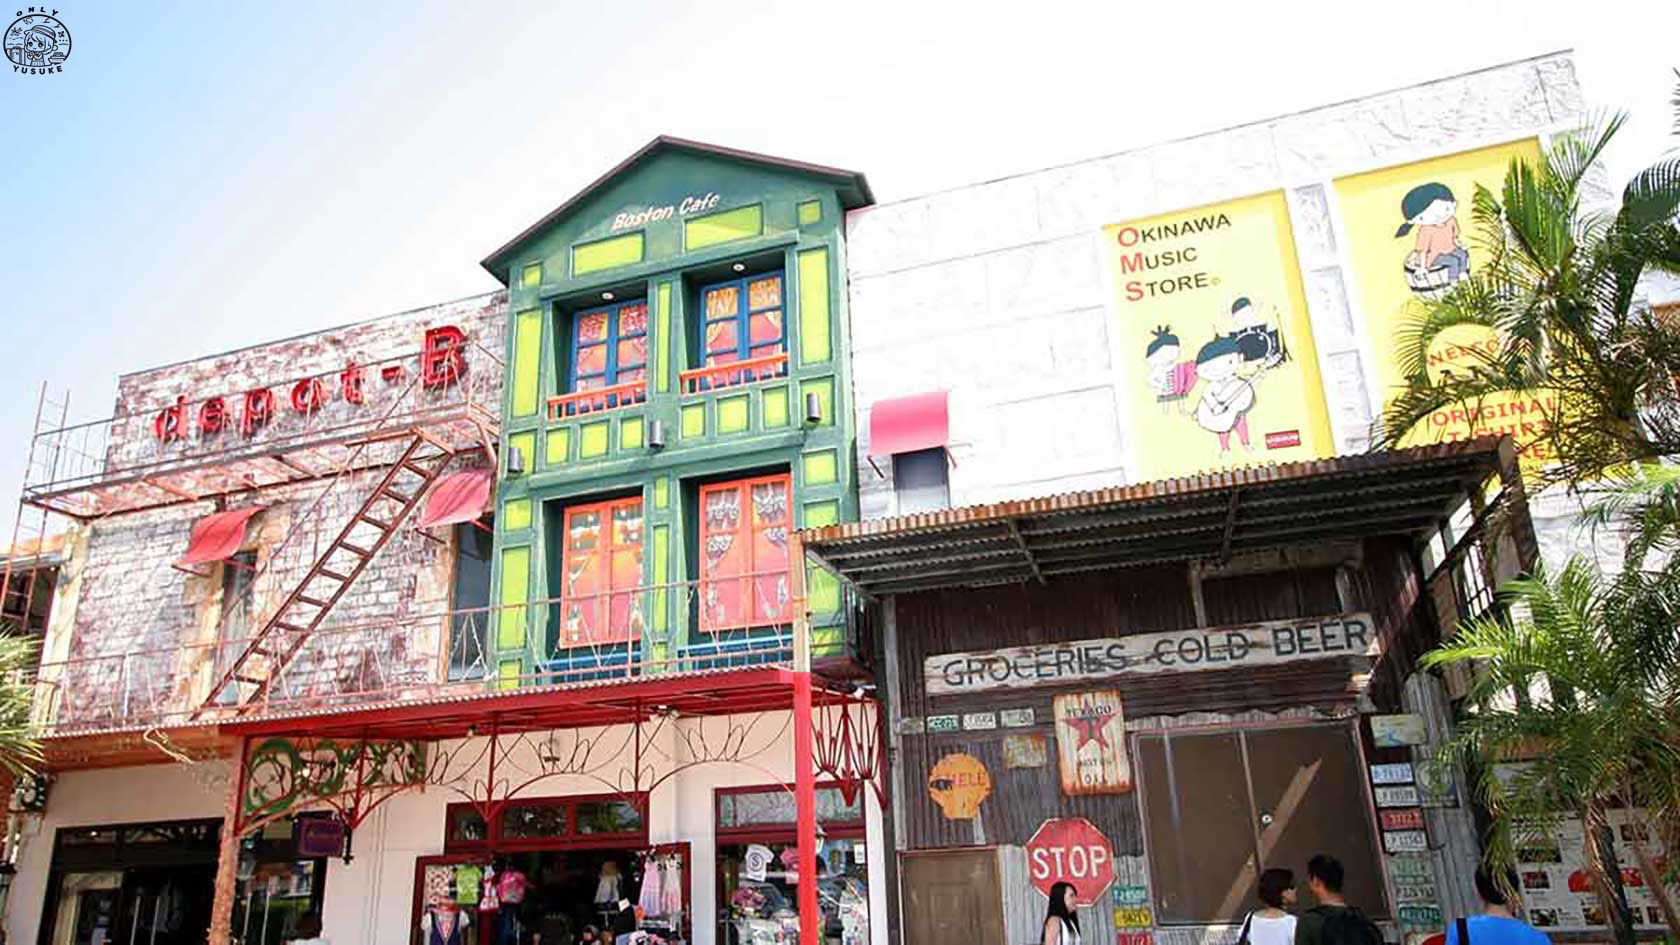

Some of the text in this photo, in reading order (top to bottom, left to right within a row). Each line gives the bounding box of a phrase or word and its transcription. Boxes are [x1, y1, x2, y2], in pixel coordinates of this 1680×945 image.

[610, 191, 721, 231] Boston Cafe
[1117, 213, 1232, 248] OKINAWA
[1120, 246, 1199, 275] MUSIC
[154, 324, 468, 443] depot-B
[1432, 397, 1557, 426] ORIGINAL
[942, 619, 1367, 687] GROCERIES COLD BEER
[1032, 844, 1107, 880] STOP
